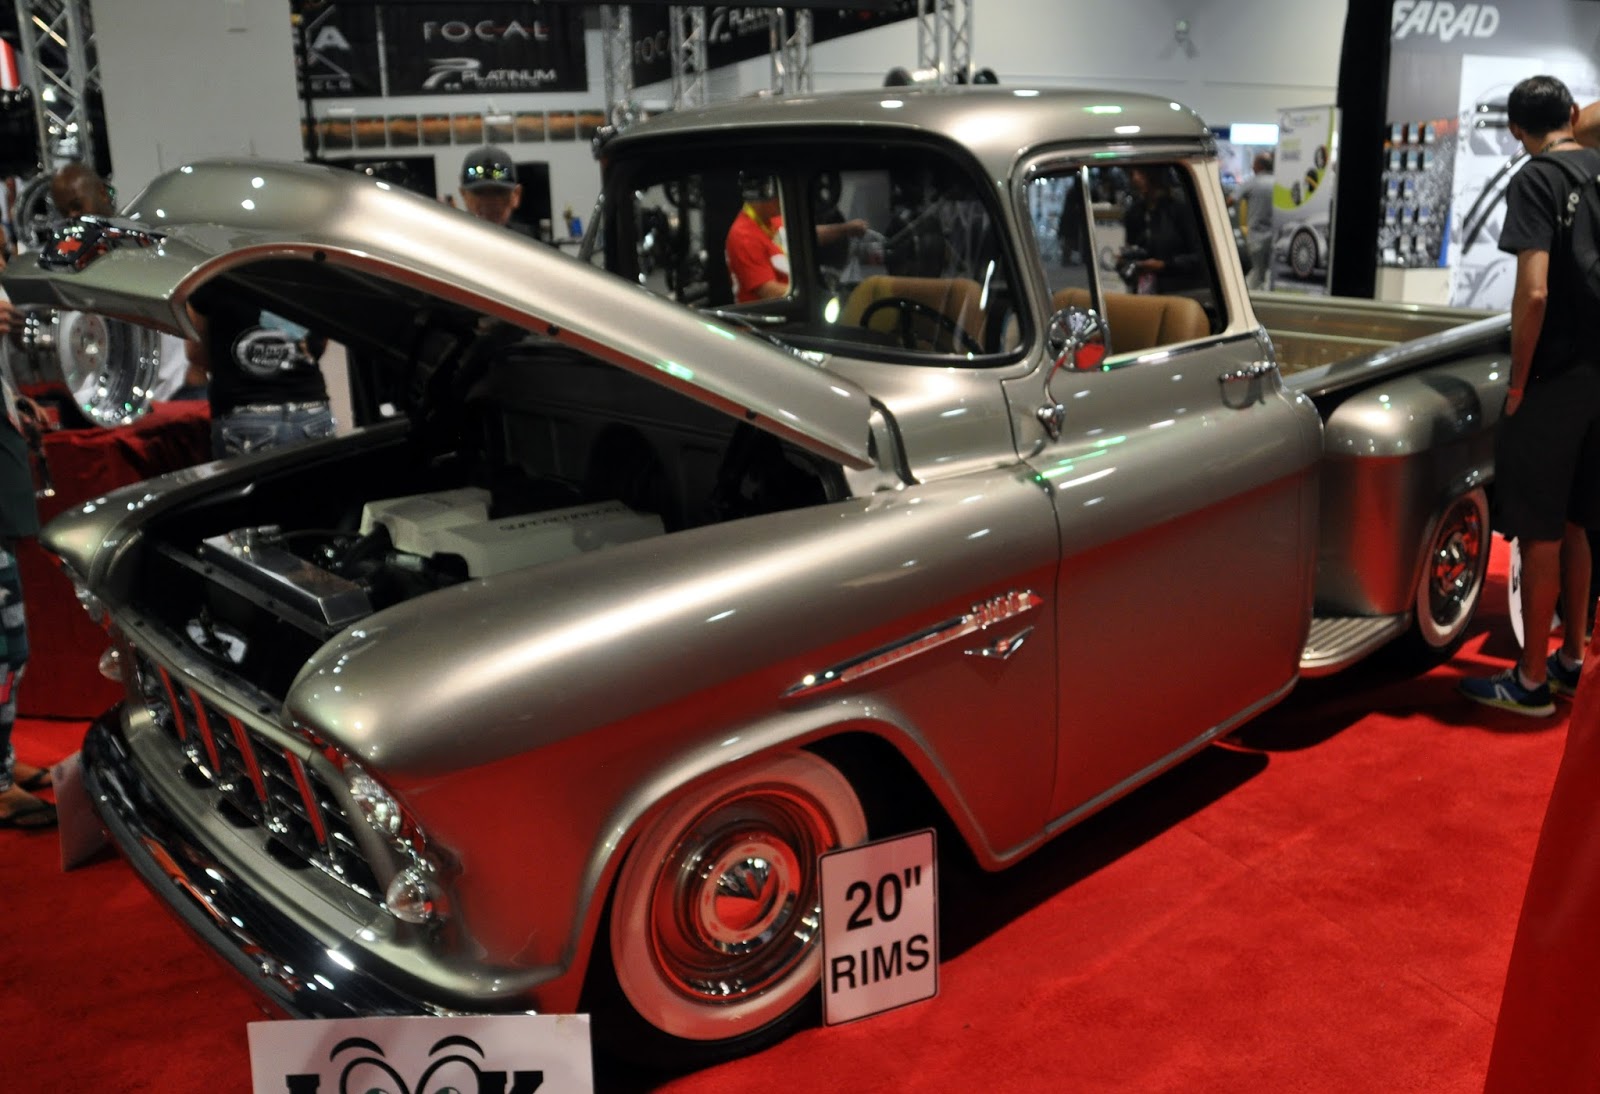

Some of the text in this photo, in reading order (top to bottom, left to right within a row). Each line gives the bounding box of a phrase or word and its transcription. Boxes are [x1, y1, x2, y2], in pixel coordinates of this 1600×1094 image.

[423, 20, 549, 43] FOCAL
[1392, 0, 1500, 42] FARAD
[461, 68, 558, 83] PLATINUM
[845, 865, 922, 932] 20"
[831, 934, 930, 993] RIMS
